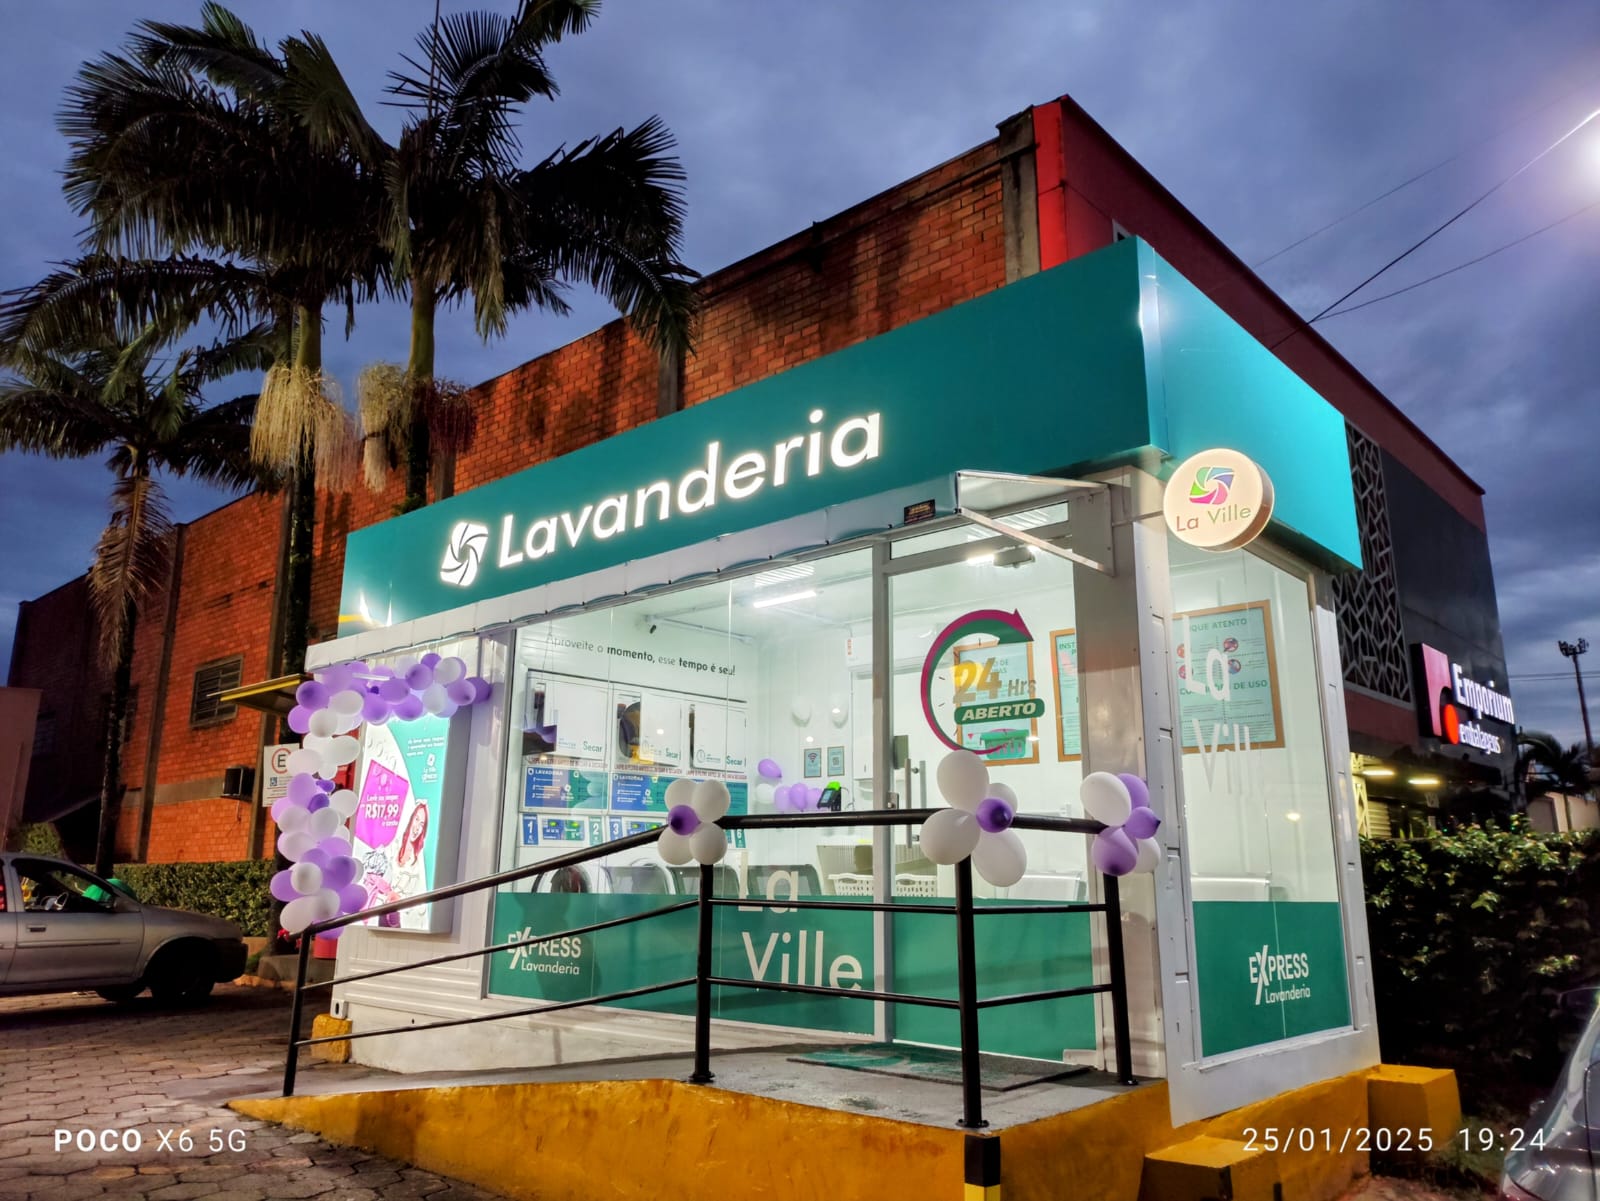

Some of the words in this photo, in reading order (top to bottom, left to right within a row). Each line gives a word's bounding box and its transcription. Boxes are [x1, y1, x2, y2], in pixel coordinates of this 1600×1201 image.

[499, 409, 881, 569] Lavanderia
[1176, 515, 1199, 532] La
[1207, 503, 1252, 524] Ville
[1212, 617, 1248, 629] ATENTO
[607, 646, 655, 663] momento,
[658, 655, 676, 666] esse
[679, 657, 708, 672] tempo
[1182, 614, 1231, 702] La
[953, 657, 1002, 704] 24
[1008, 678, 1037, 698] Hrs
[1248, 679, 1268, 689] USO
[1451, 662, 1515, 725] Emporium
[962, 702, 1036, 721] ABERTO
[583, 741, 602, 753] Secar
[1458, 720, 1501, 755] embalagens
[277, 754, 287, 768] E
[665, 747, 679, 760] Secar
[726, 755, 743, 766] Secar
[738, 851, 799, 914] La
[507, 926, 582, 970] EXPRESS
[521, 959, 580, 975] Lavanderia
[742, 930, 863, 997] Ville
[1248, 944, 1309, 1005] EXPRESS
[1264, 984, 1311, 1004] Lavanderia
